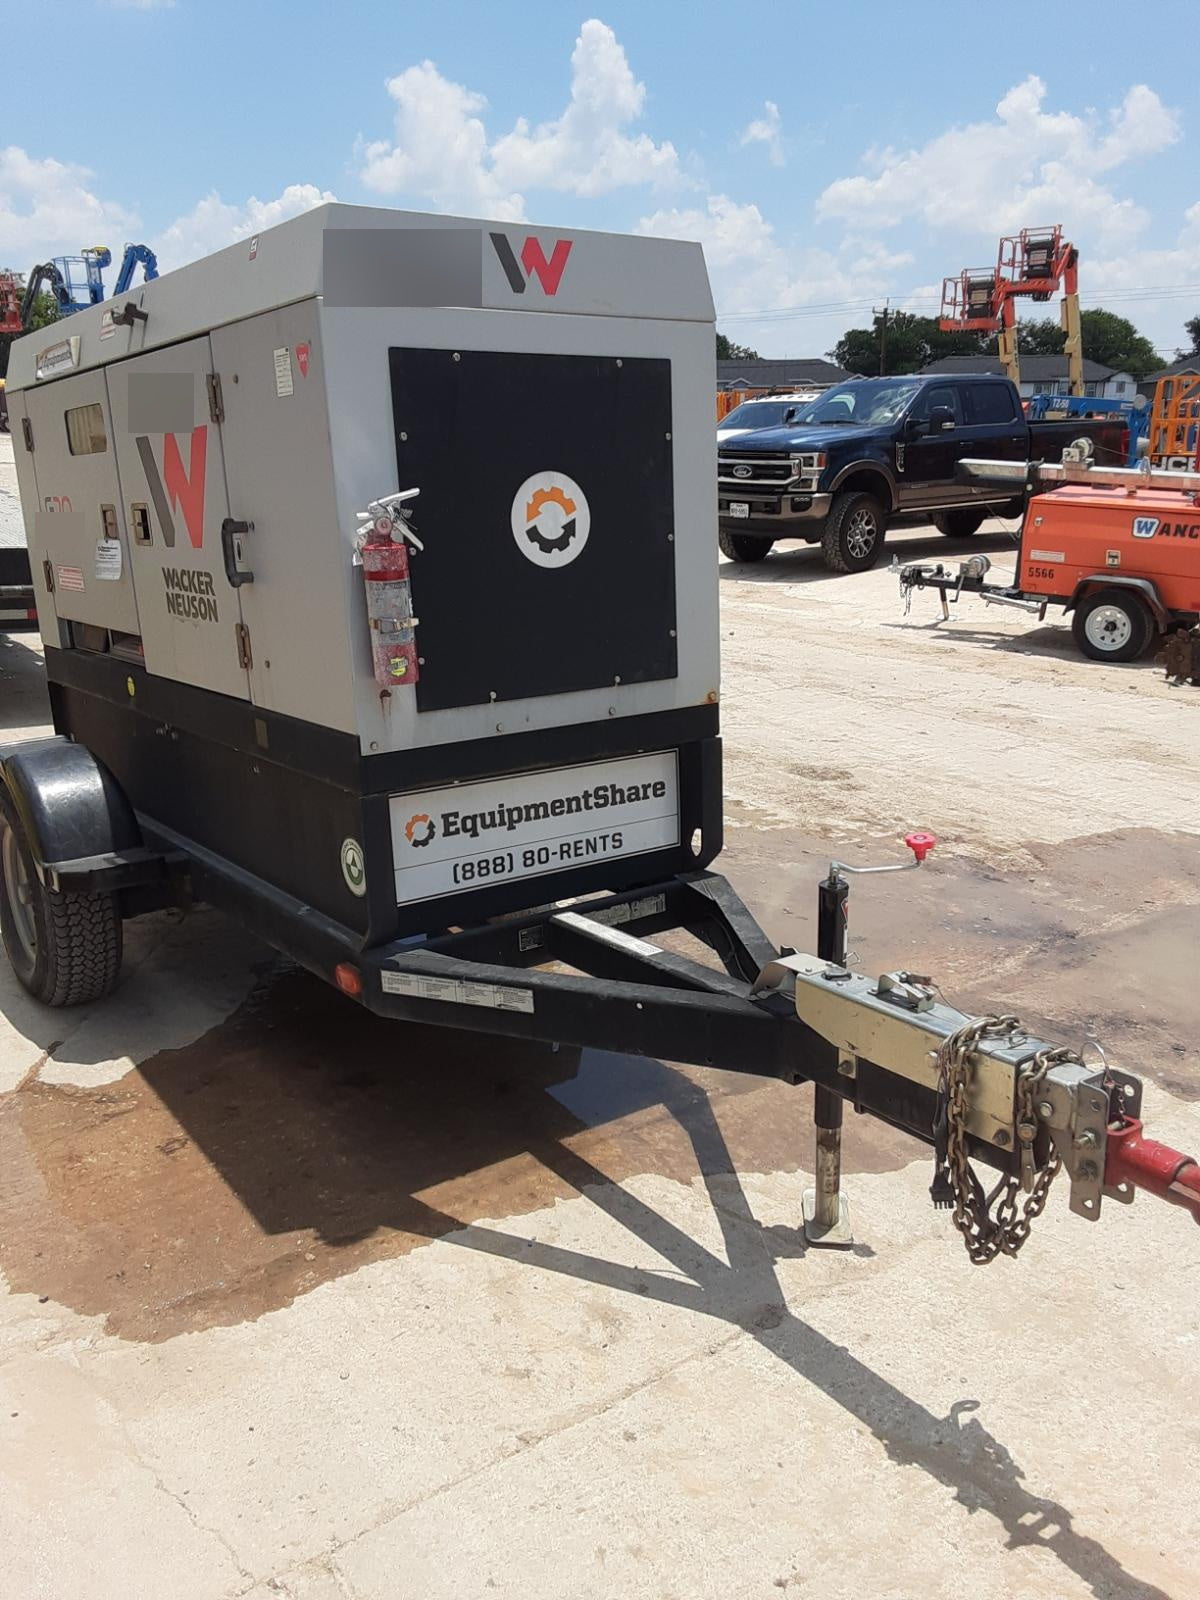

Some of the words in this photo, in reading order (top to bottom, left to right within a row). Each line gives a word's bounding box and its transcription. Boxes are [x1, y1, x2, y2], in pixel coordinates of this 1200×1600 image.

[161, 566, 216, 597] WACKER
[1028, 567, 1055, 579] 5566
[165, 592, 219, 623] NEUSON
[441, 779, 666, 838] EquipmentShare
[453, 853, 514, 884] (888)
[522, 832, 624, 868] 80-RENTS
